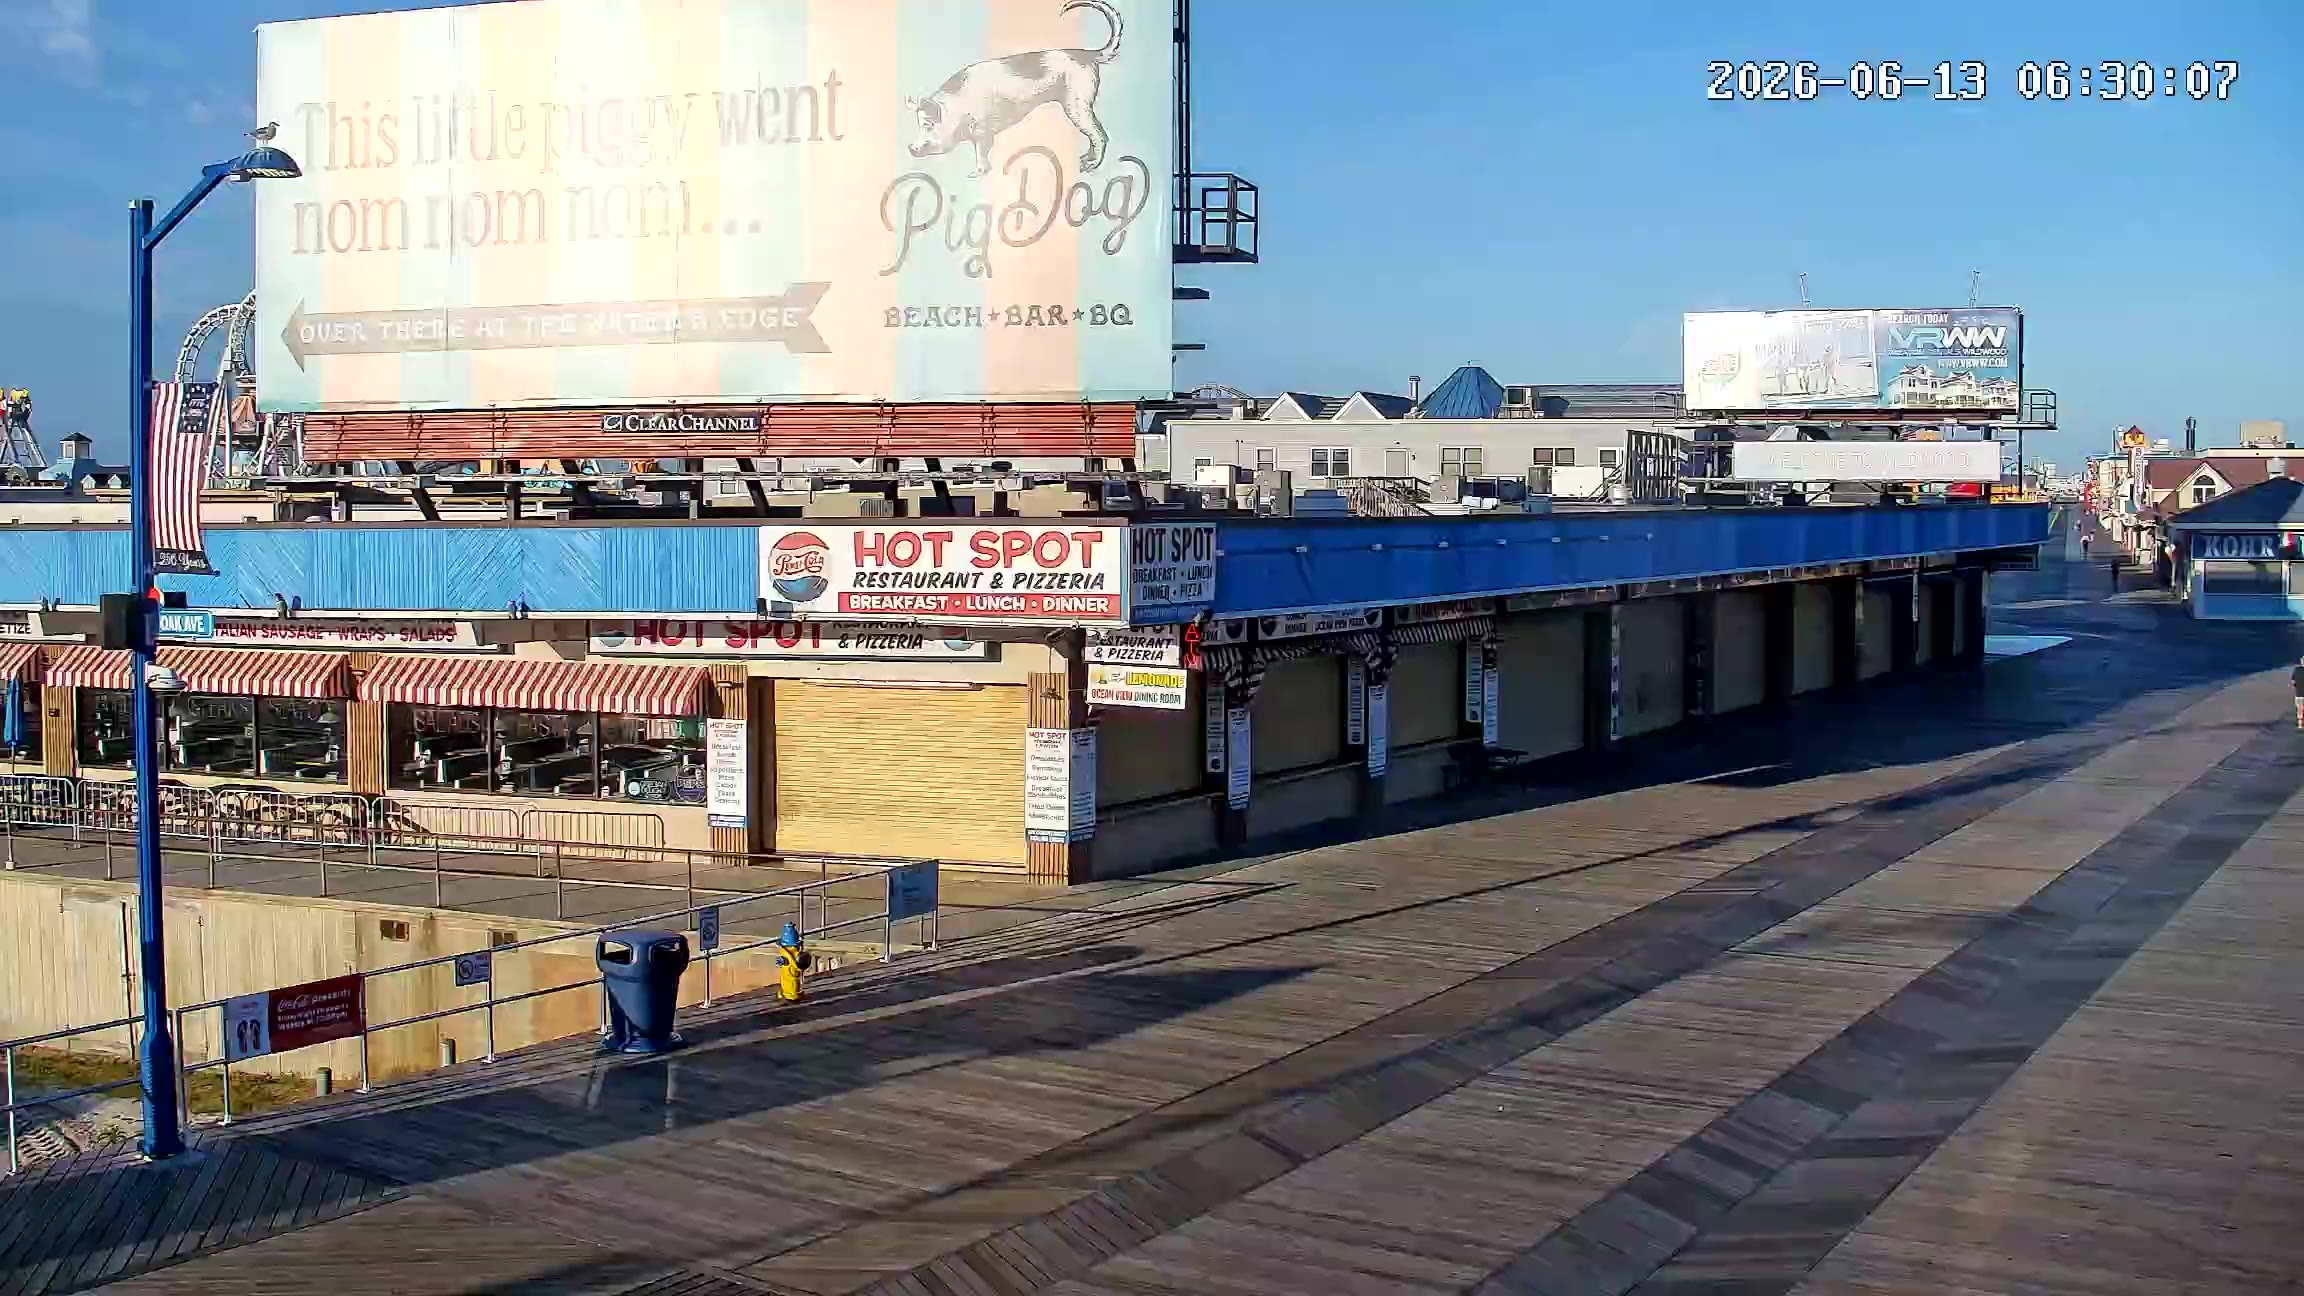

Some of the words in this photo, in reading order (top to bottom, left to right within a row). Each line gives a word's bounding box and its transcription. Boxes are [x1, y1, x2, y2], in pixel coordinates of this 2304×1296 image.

[297, 100, 399, 171] This
[411, 89, 527, 165] little
[539, 83, 701, 175] piggy
[711, 67, 845, 147] went
[292, 197, 410, 255] nom
[299, 321, 369, 345] OVER
[378, 317, 466, 340] THERE
[478, 316, 506, 338] AT
[720, 305, 800, 329] EDGE
[883, 305, 984, 329] BEACH
[1003, 303, 1069, 328] BAR
[1088, 302, 1135, 327] BQ
[1922, 312, 1949, 325] TODAY
[1888, 326, 2009, 349] VRWW
[853, 530, 953, 568] HOT
[969, 530, 1103, 568] SPOT
[1132, 527, 1167, 564] HOT
[1170, 526, 1215, 563] SPOT
[851, 571, 984, 590] RESTAURANT
[989, 571, 1004, 590] &
[1012, 571, 1105, 591] PIZZERIA
[1132, 567, 1177, 585] BREAKFAST
[849, 594, 948, 611] BREAKFAST
[966, 595, 1026, 612] LUNCH
[1042, 596, 1110, 614] DINNER
[160, 615, 182, 632] OAK
[184, 615, 205, 633] AVE
[262, 624, 325, 640] SAUSAGE
[336, 626, 386, 641] WRAPS
[400, 627, 457, 642] SALADS
[724, 620, 821, 649] SPOT
[837, 633, 849, 649] &
[855, 633, 925, 649] PIZZERIA
[1094, 647, 1103, 658] &
[1107, 647, 1165, 661] PIZZERIA
[1091, 688, 1114, 701] OCEAN
[1115, 689, 1133, 702] VIEW
[1134, 691, 1159, 704] DINING
[1160, 692, 1181, 705] ROOM
[1046, 732, 1067, 740] SPOT
